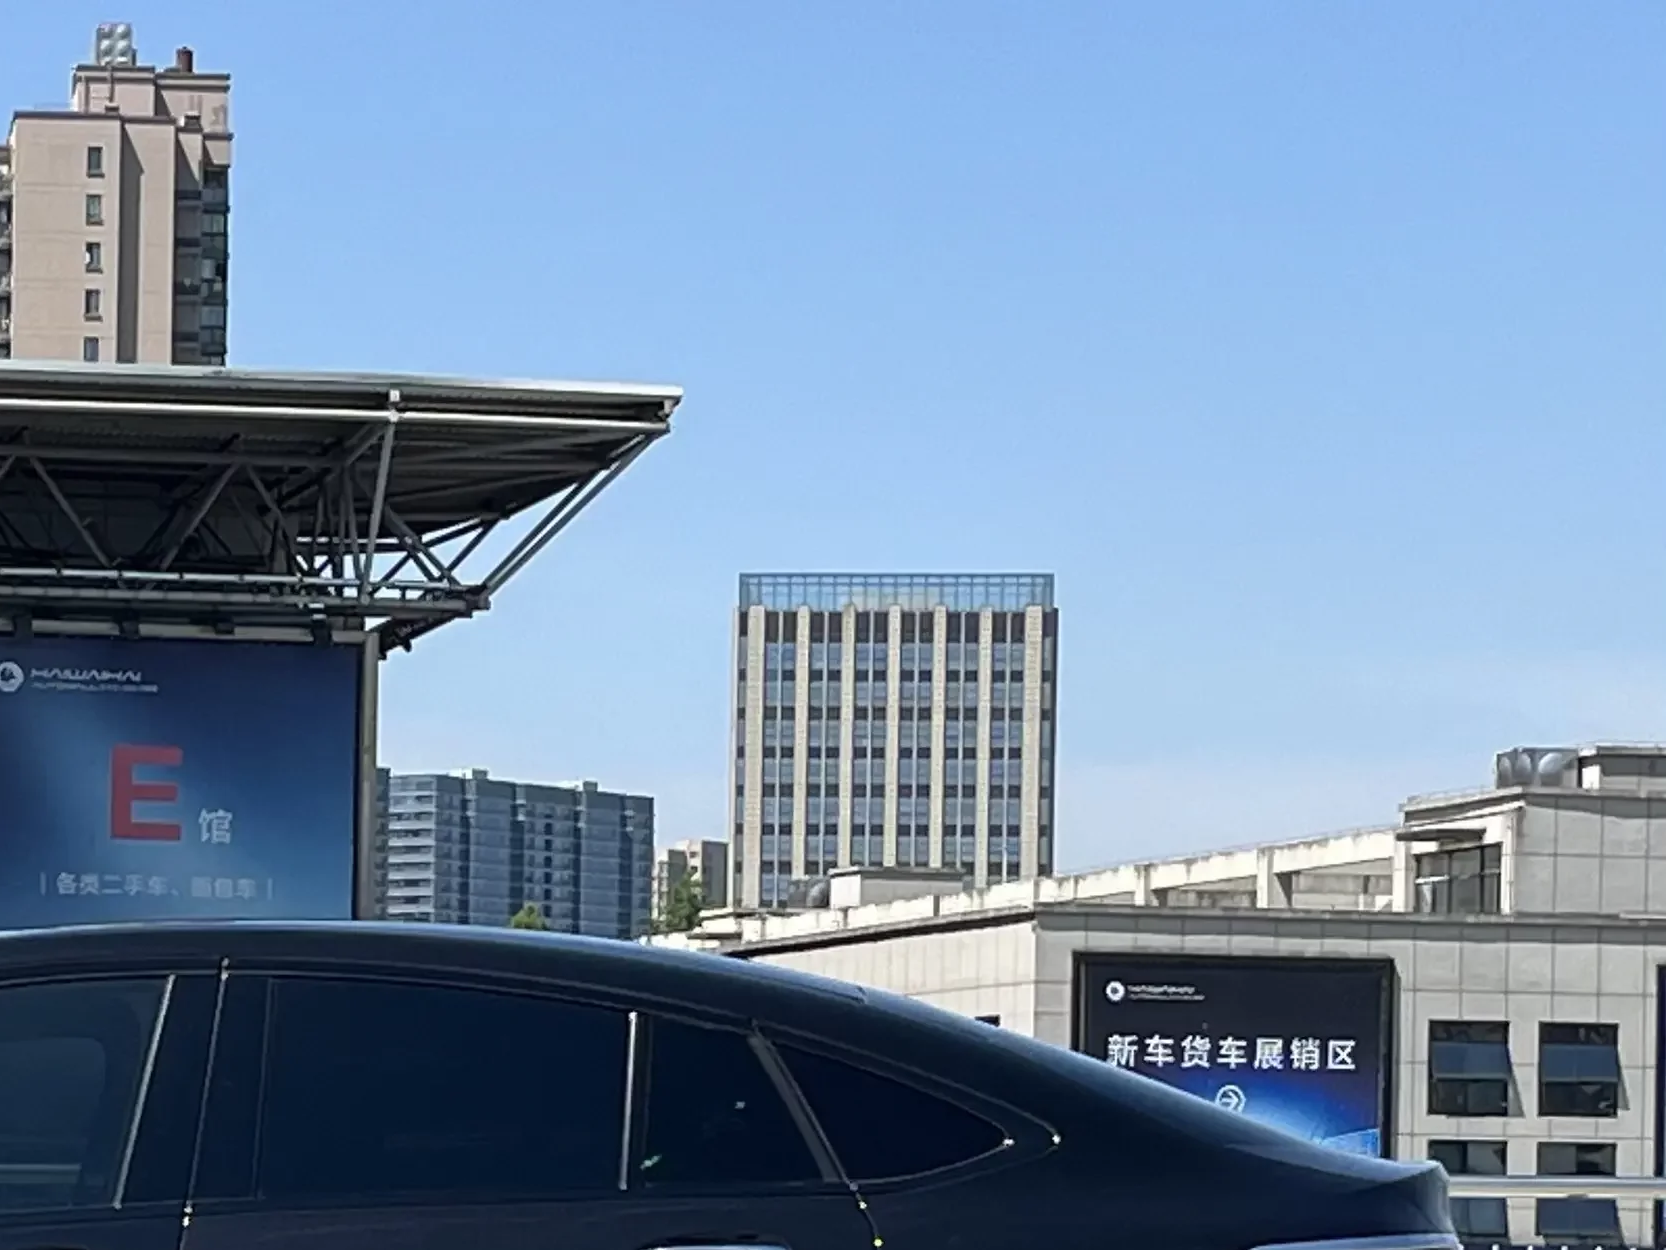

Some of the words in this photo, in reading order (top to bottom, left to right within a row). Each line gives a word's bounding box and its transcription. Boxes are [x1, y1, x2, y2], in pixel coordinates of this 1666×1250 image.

[110, 742, 183, 841] E
[198, 808, 233, 844] 馆
[1107, 1034, 1357, 1070] 新车货车展销区
